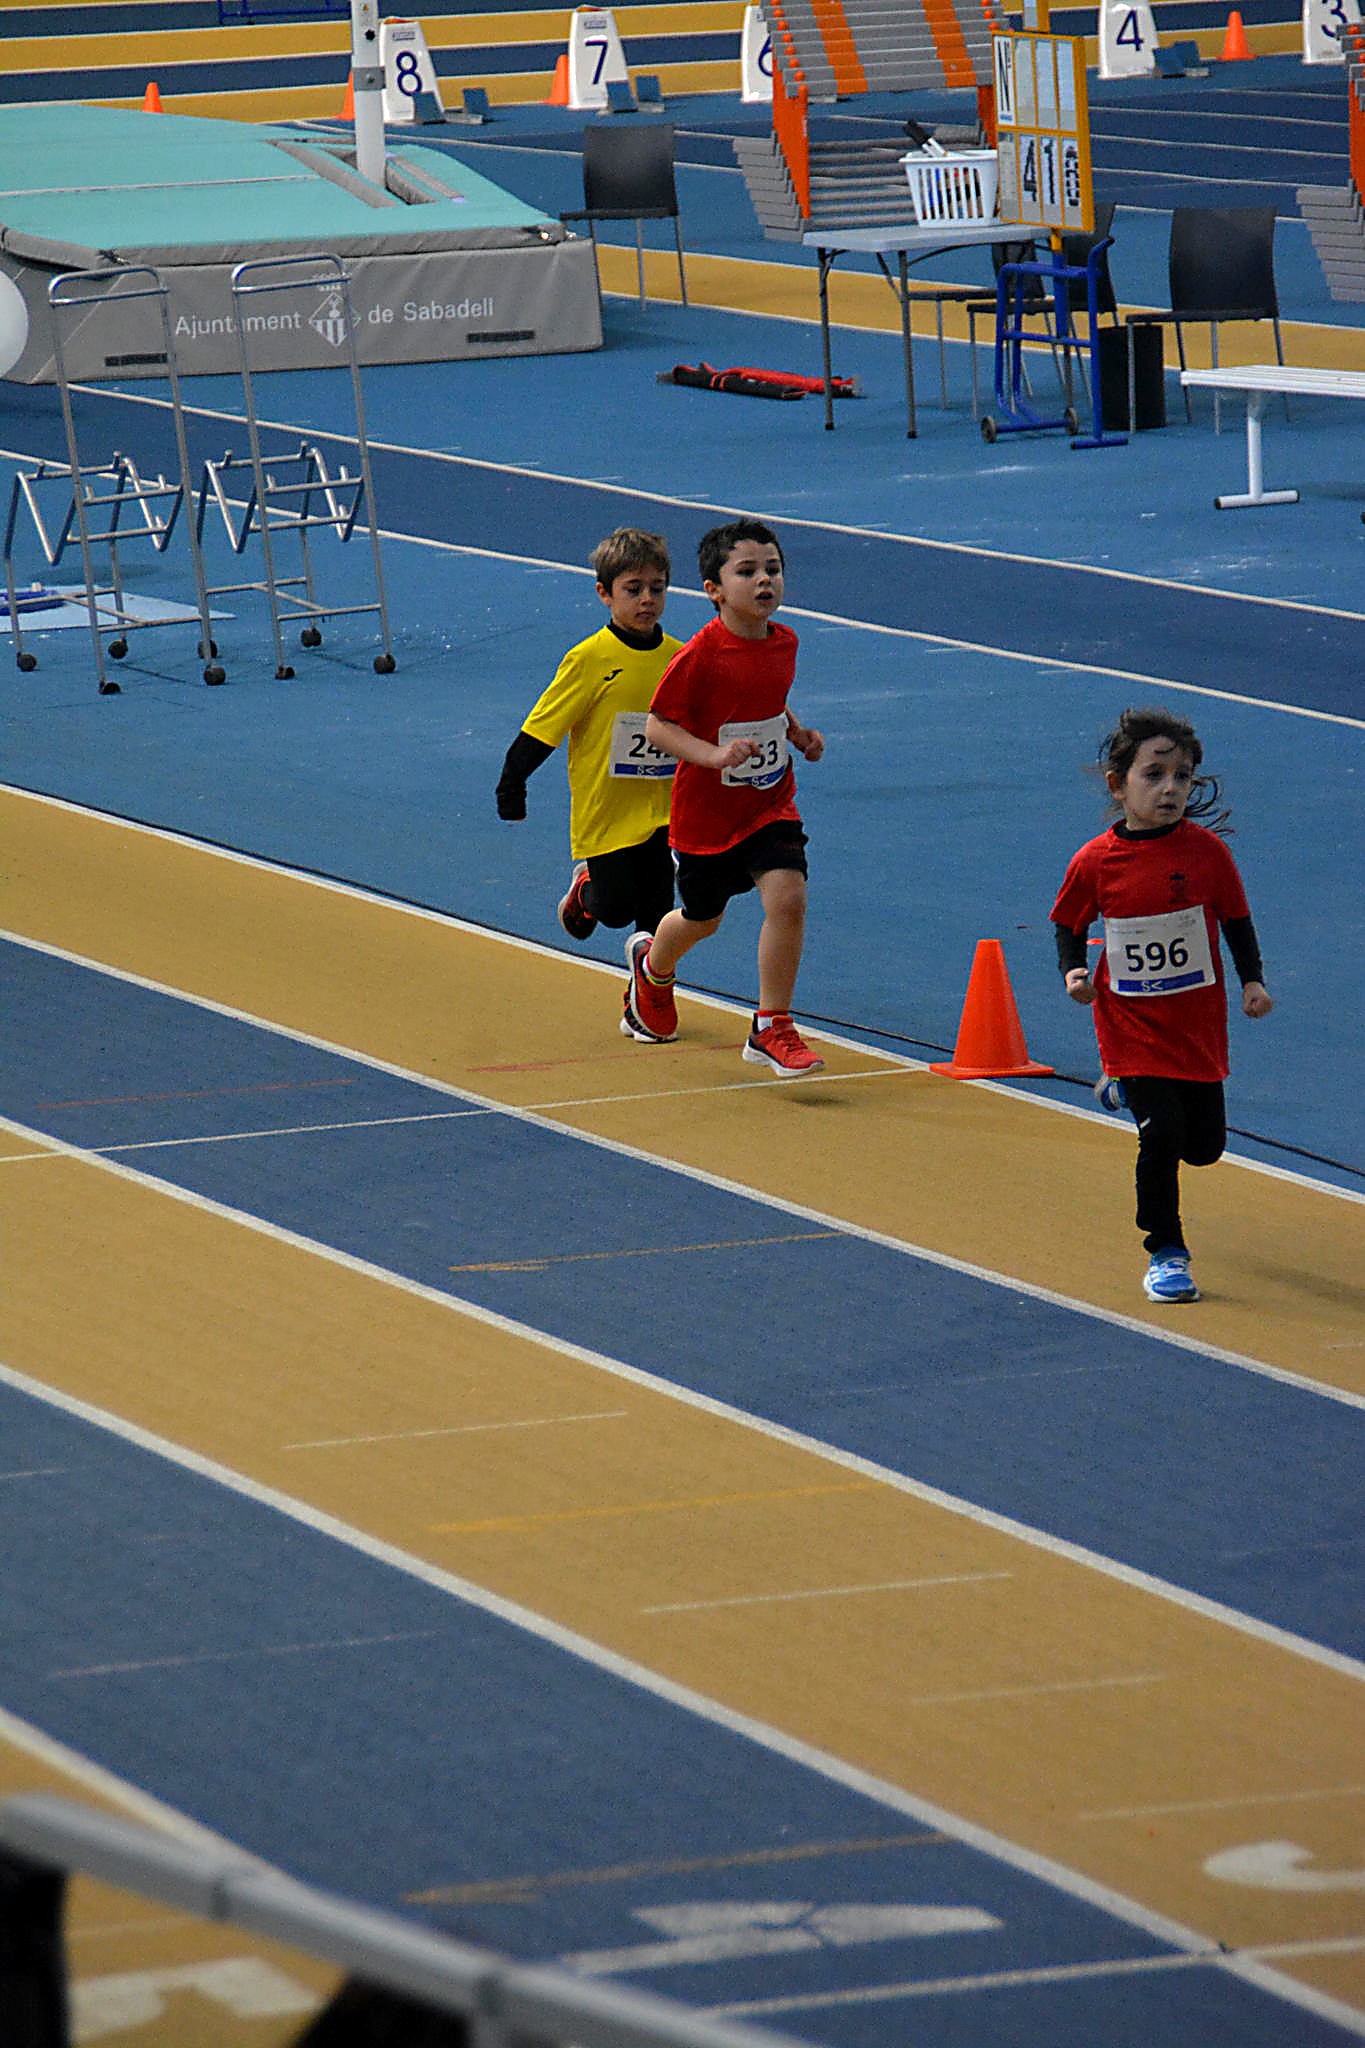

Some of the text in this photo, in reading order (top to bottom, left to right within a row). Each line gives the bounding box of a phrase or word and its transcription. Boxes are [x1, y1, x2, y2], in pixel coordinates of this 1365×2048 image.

[1116, 9, 1144, 51] 4
[1320, 0, 1347, 38] 3
[396, 51, 422, 96] 8
[584, 38, 608, 85] 7
[368, 304, 394, 325] de
[403, 298, 494, 322] Sabadell
[629, 734, 672, 759] 24
[751, 740, 778, 769] 53
[1125, 938, 1189, 972] 596
